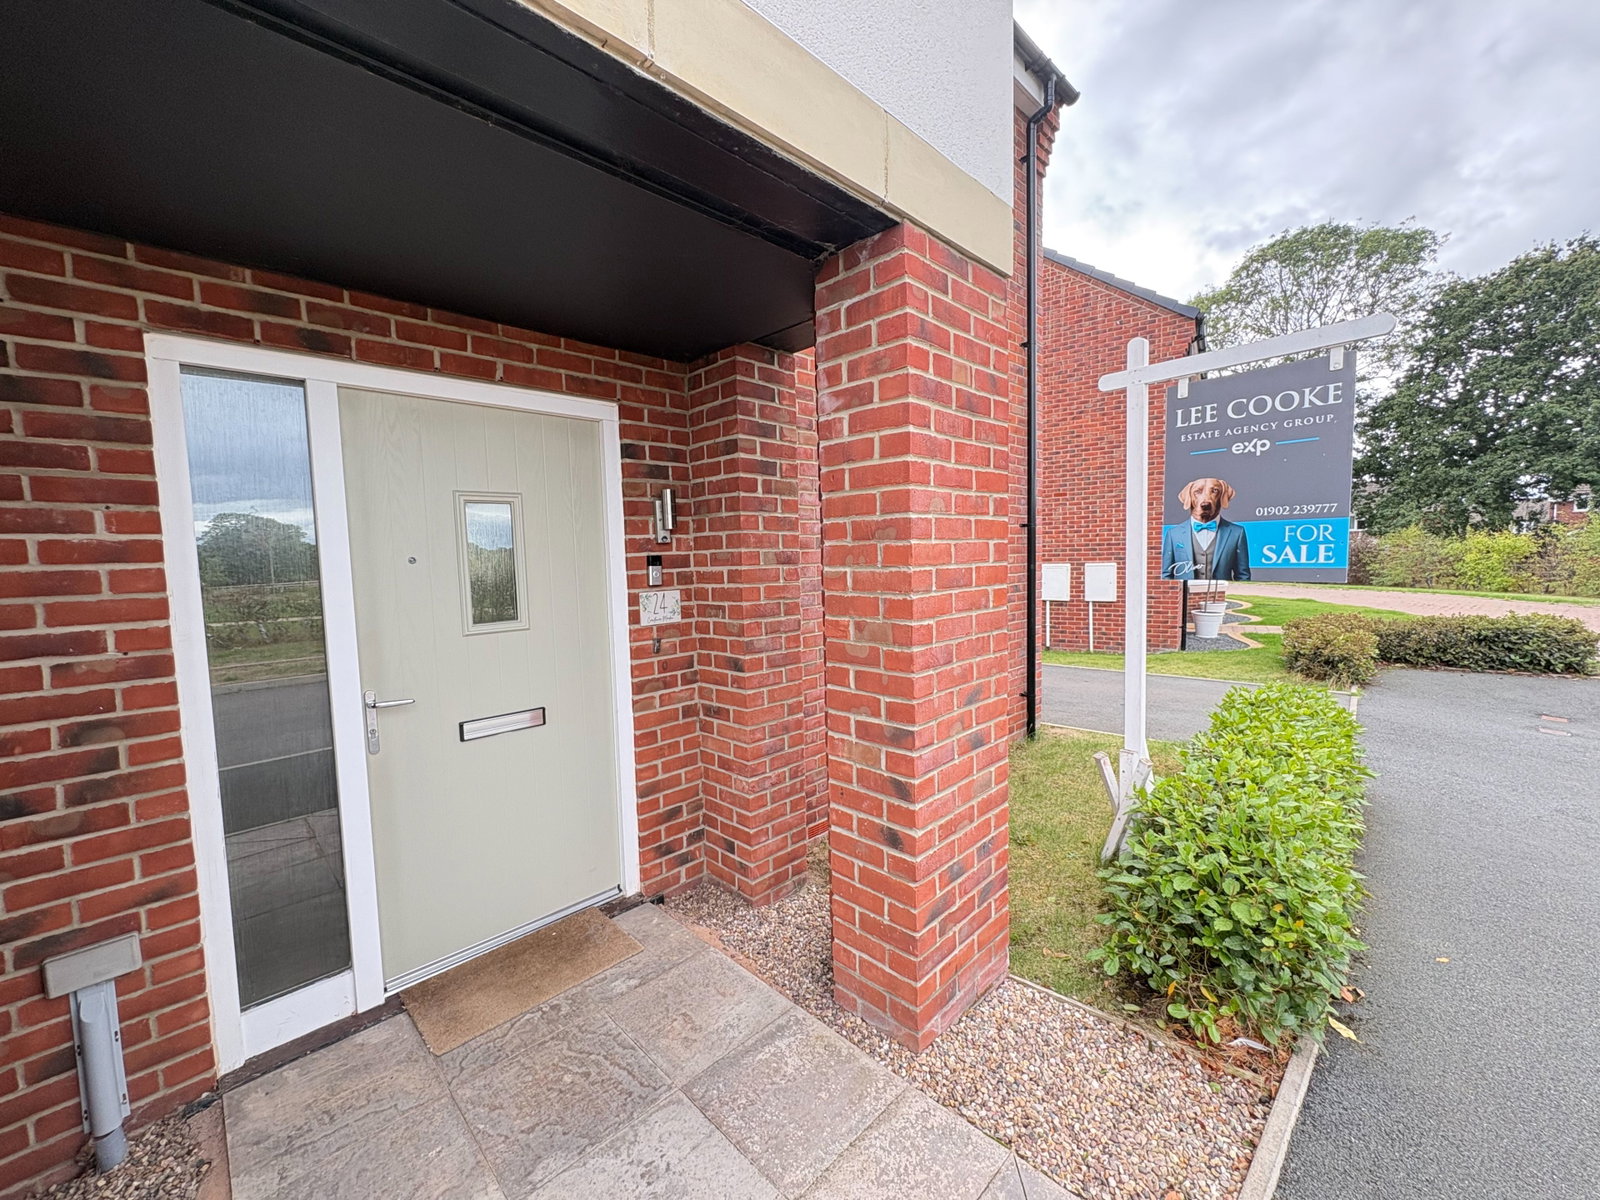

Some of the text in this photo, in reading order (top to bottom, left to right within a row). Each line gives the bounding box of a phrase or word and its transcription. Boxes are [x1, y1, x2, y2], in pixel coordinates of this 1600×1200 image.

[1176, 382, 1343, 428] LEE COOKE
[1181, 429, 1221, 443] ESTATE
[1225, 421, 1279, 437] AGENCY
[1255, 503, 1338, 517] 01902 239777
[1284, 524, 1336, 543] FOR
[1261, 543, 1336, 565] SALE
[652, 592, 668, 615] 24
